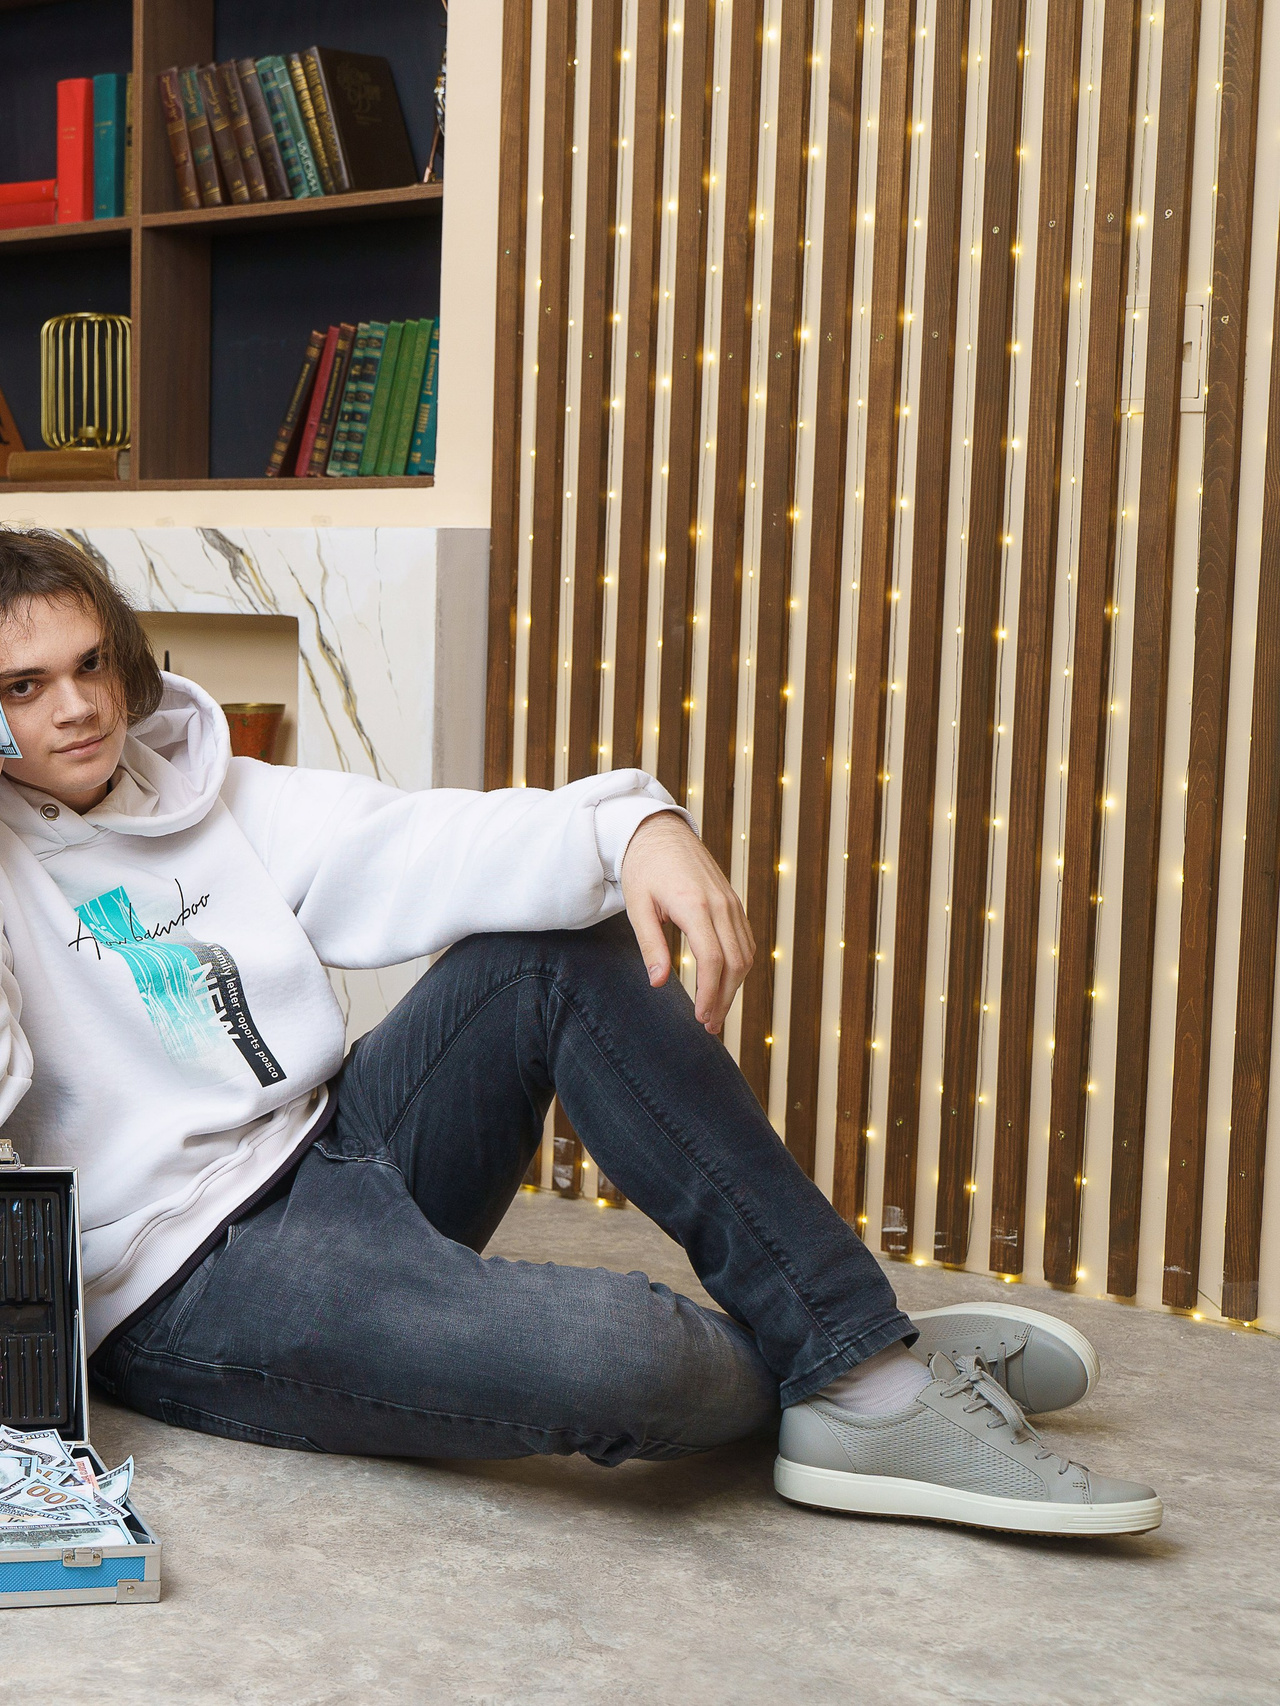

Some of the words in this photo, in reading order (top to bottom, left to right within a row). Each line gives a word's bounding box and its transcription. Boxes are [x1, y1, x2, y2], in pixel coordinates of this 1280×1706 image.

[189, 961, 241, 1040] NEW
[211, 946, 232, 976] family
[225, 976, 241, 1010] letter
[235, 1010, 261, 1050] roports
[255, 1050, 279, 1079] poaco
